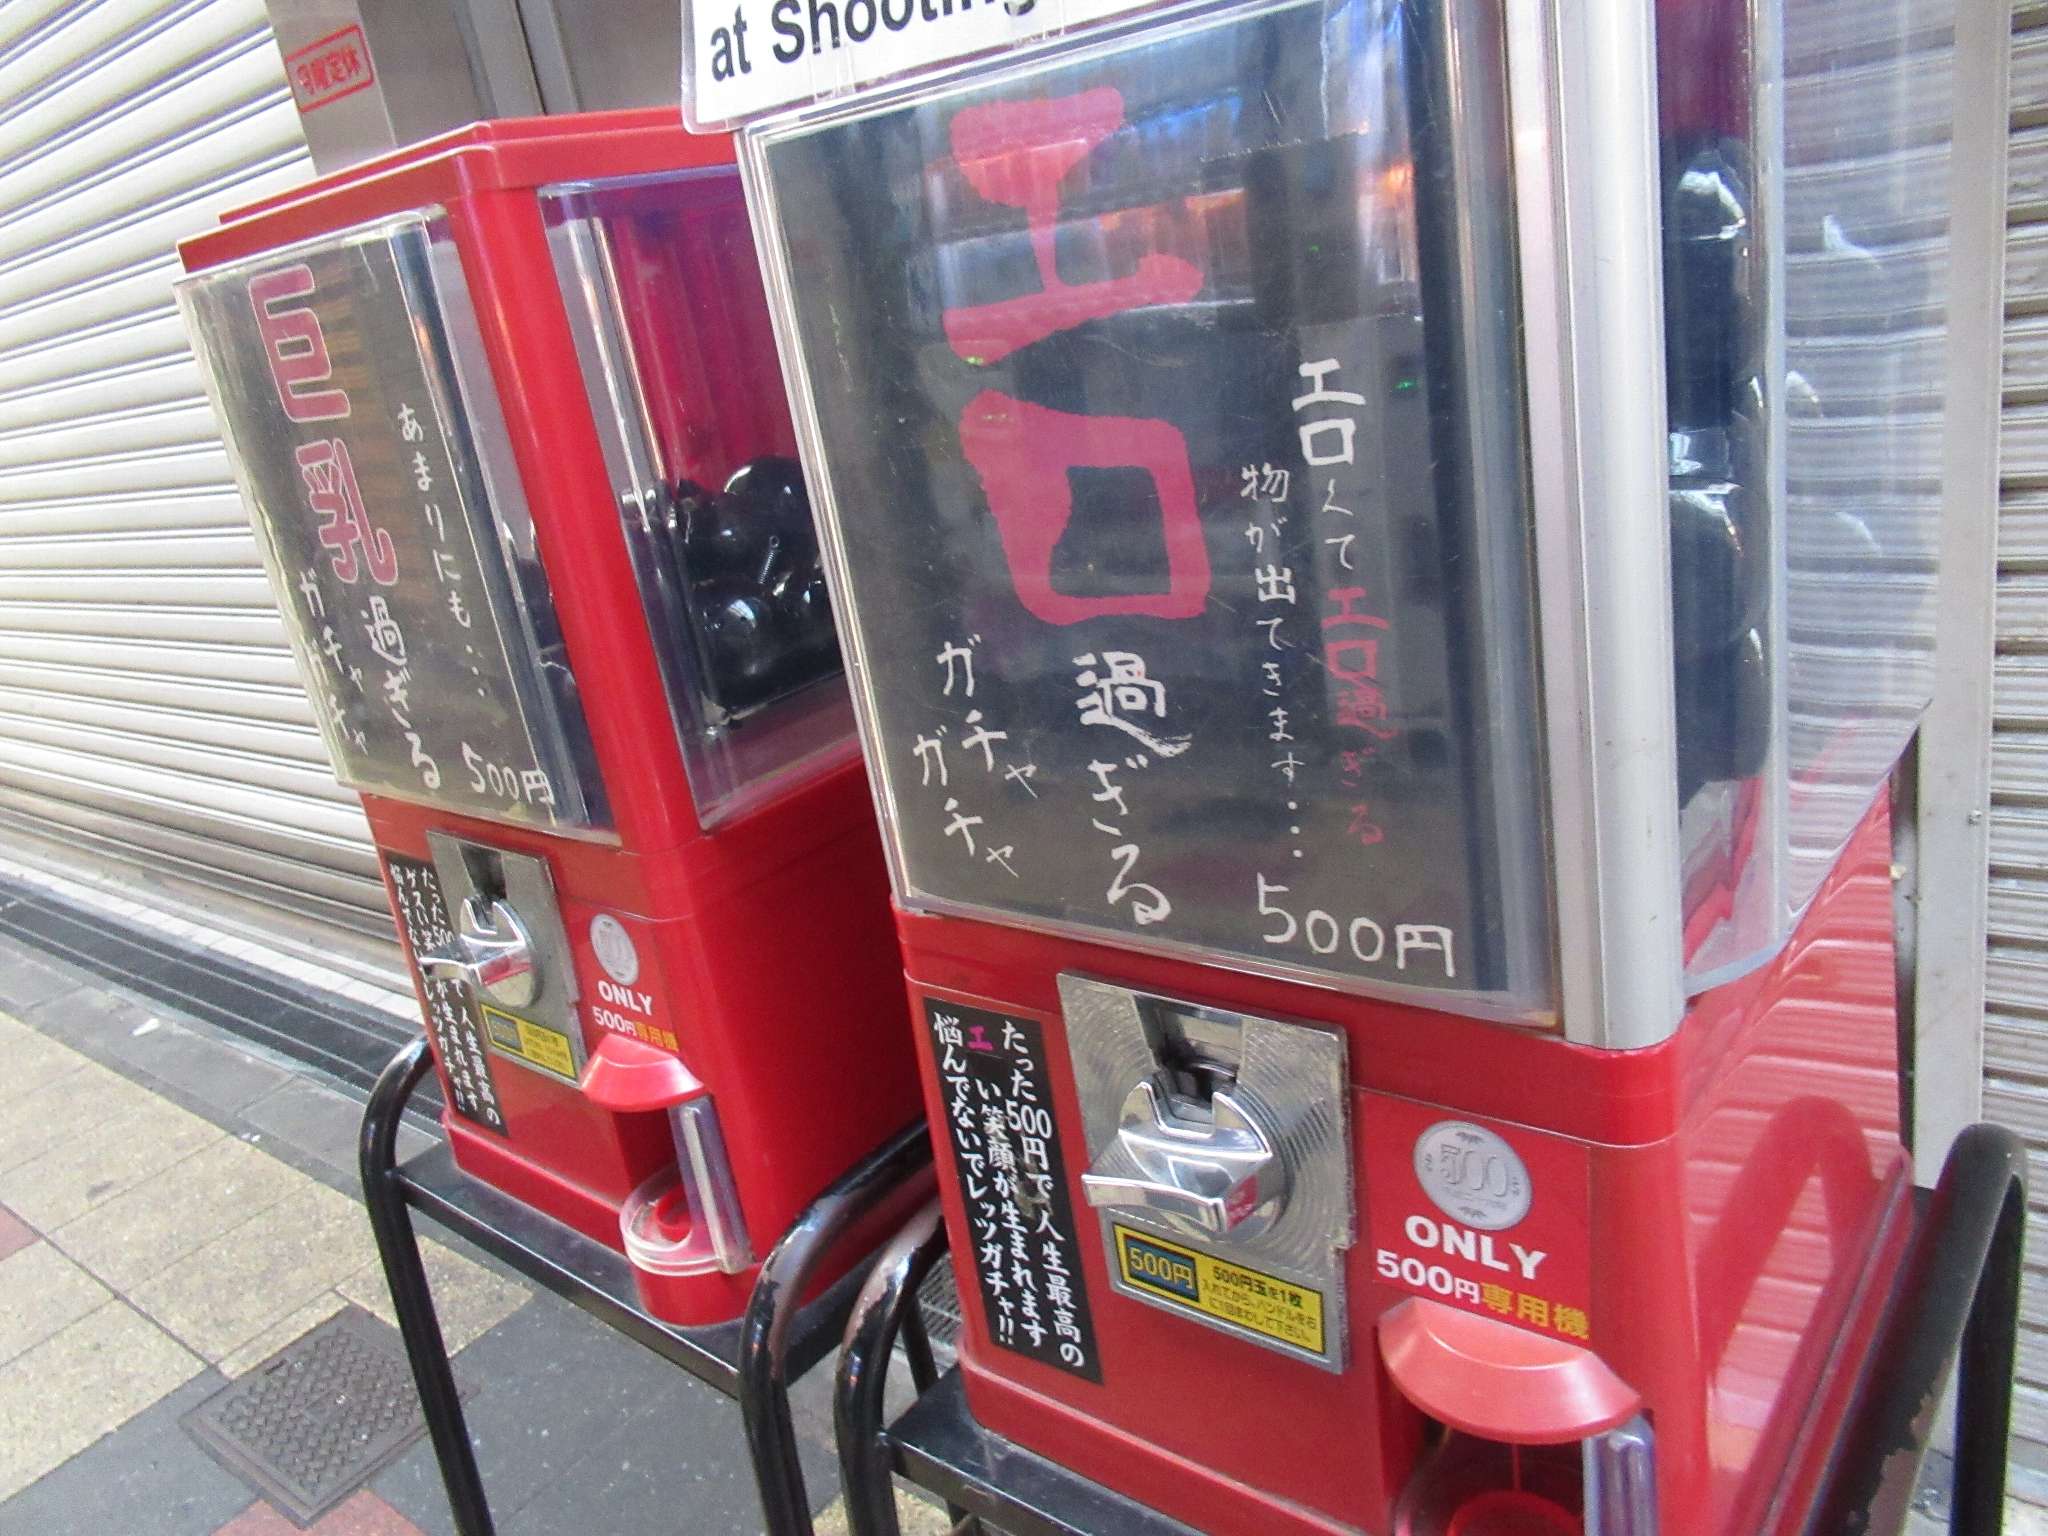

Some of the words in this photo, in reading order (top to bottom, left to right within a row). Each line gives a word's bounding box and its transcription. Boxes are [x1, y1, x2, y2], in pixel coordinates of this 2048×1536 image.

[710, 4, 751, 82] at
[772, 0, 1038, 63] Shoo
[460, 741, 556, 806] 500円
[1257, 873, 1455, 978] 500円
[598, 980, 653, 1016] ONLY
[1130, 1246, 1194, 1290] 500円
[1405, 1215, 1547, 1280] ONLY
